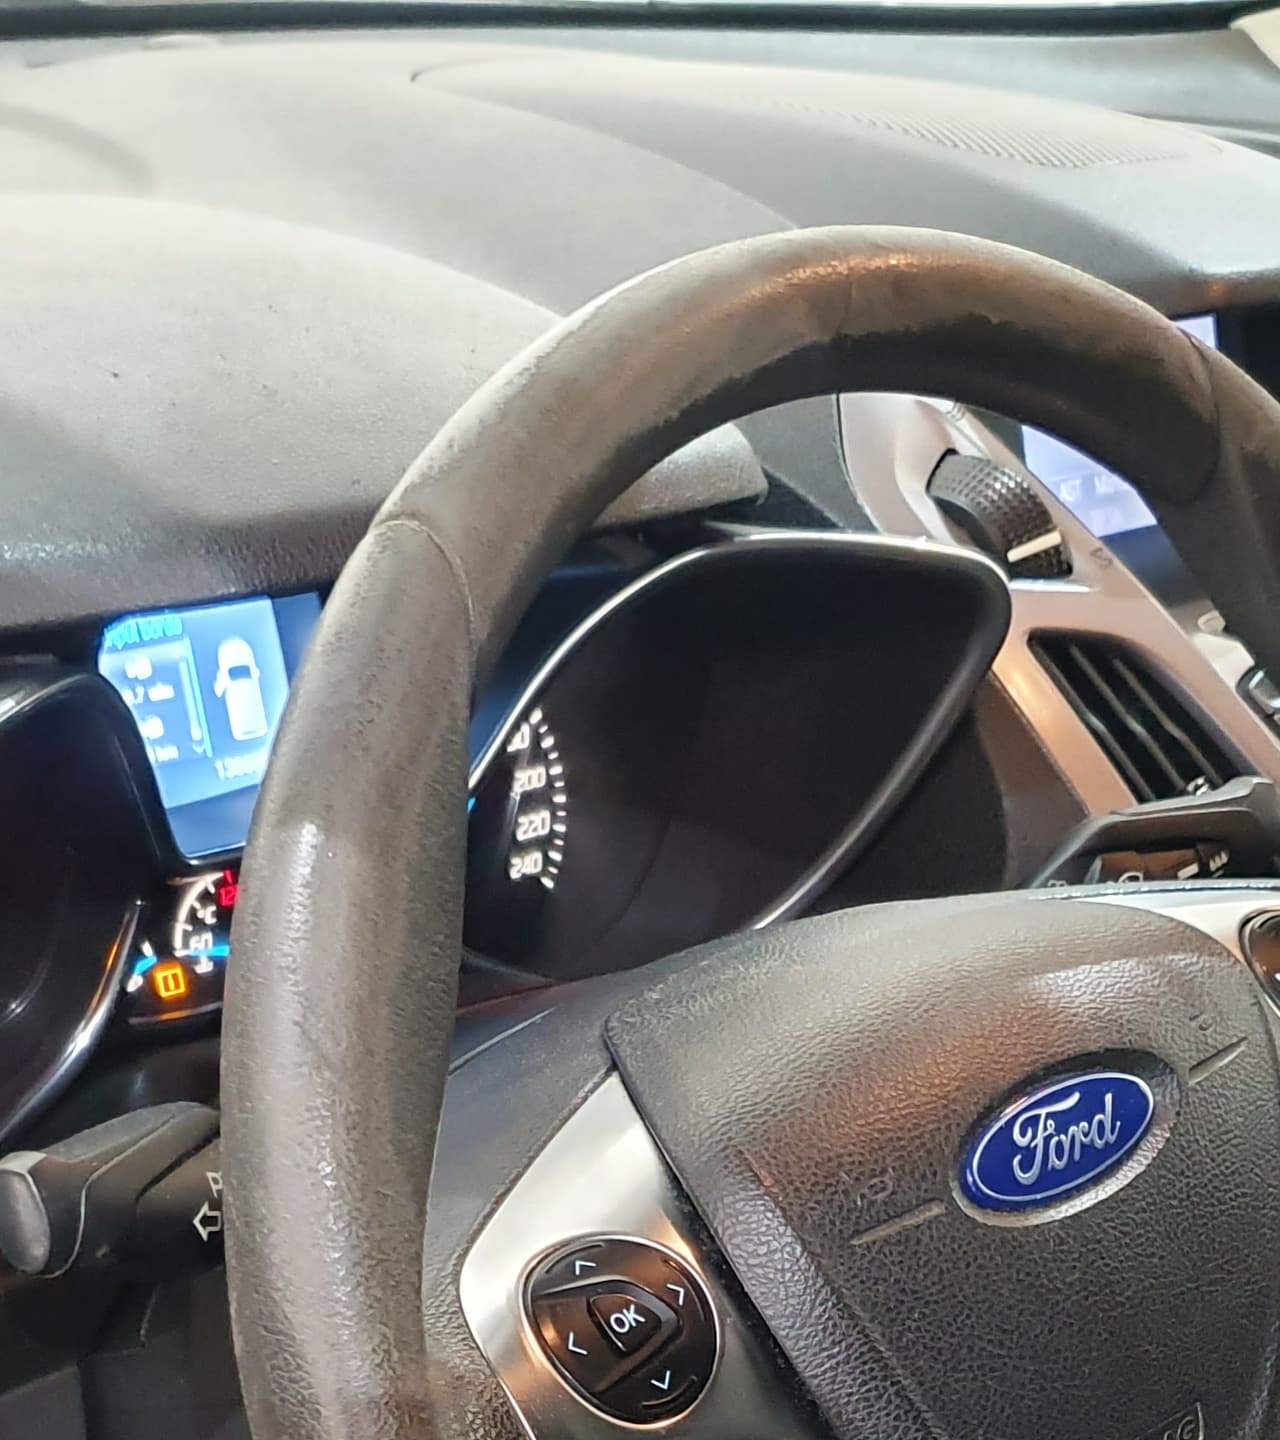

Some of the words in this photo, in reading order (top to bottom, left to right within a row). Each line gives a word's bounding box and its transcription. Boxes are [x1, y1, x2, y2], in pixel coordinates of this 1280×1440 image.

[513, 765, 547, 793] 200
[516, 809, 551, 841] 220
[509, 850, 544, 880] 240
[219, 884, 238, 907] 12
[1012, 1091, 1121, 1186] Ford
[610, 1303, 646, 1334] OK
